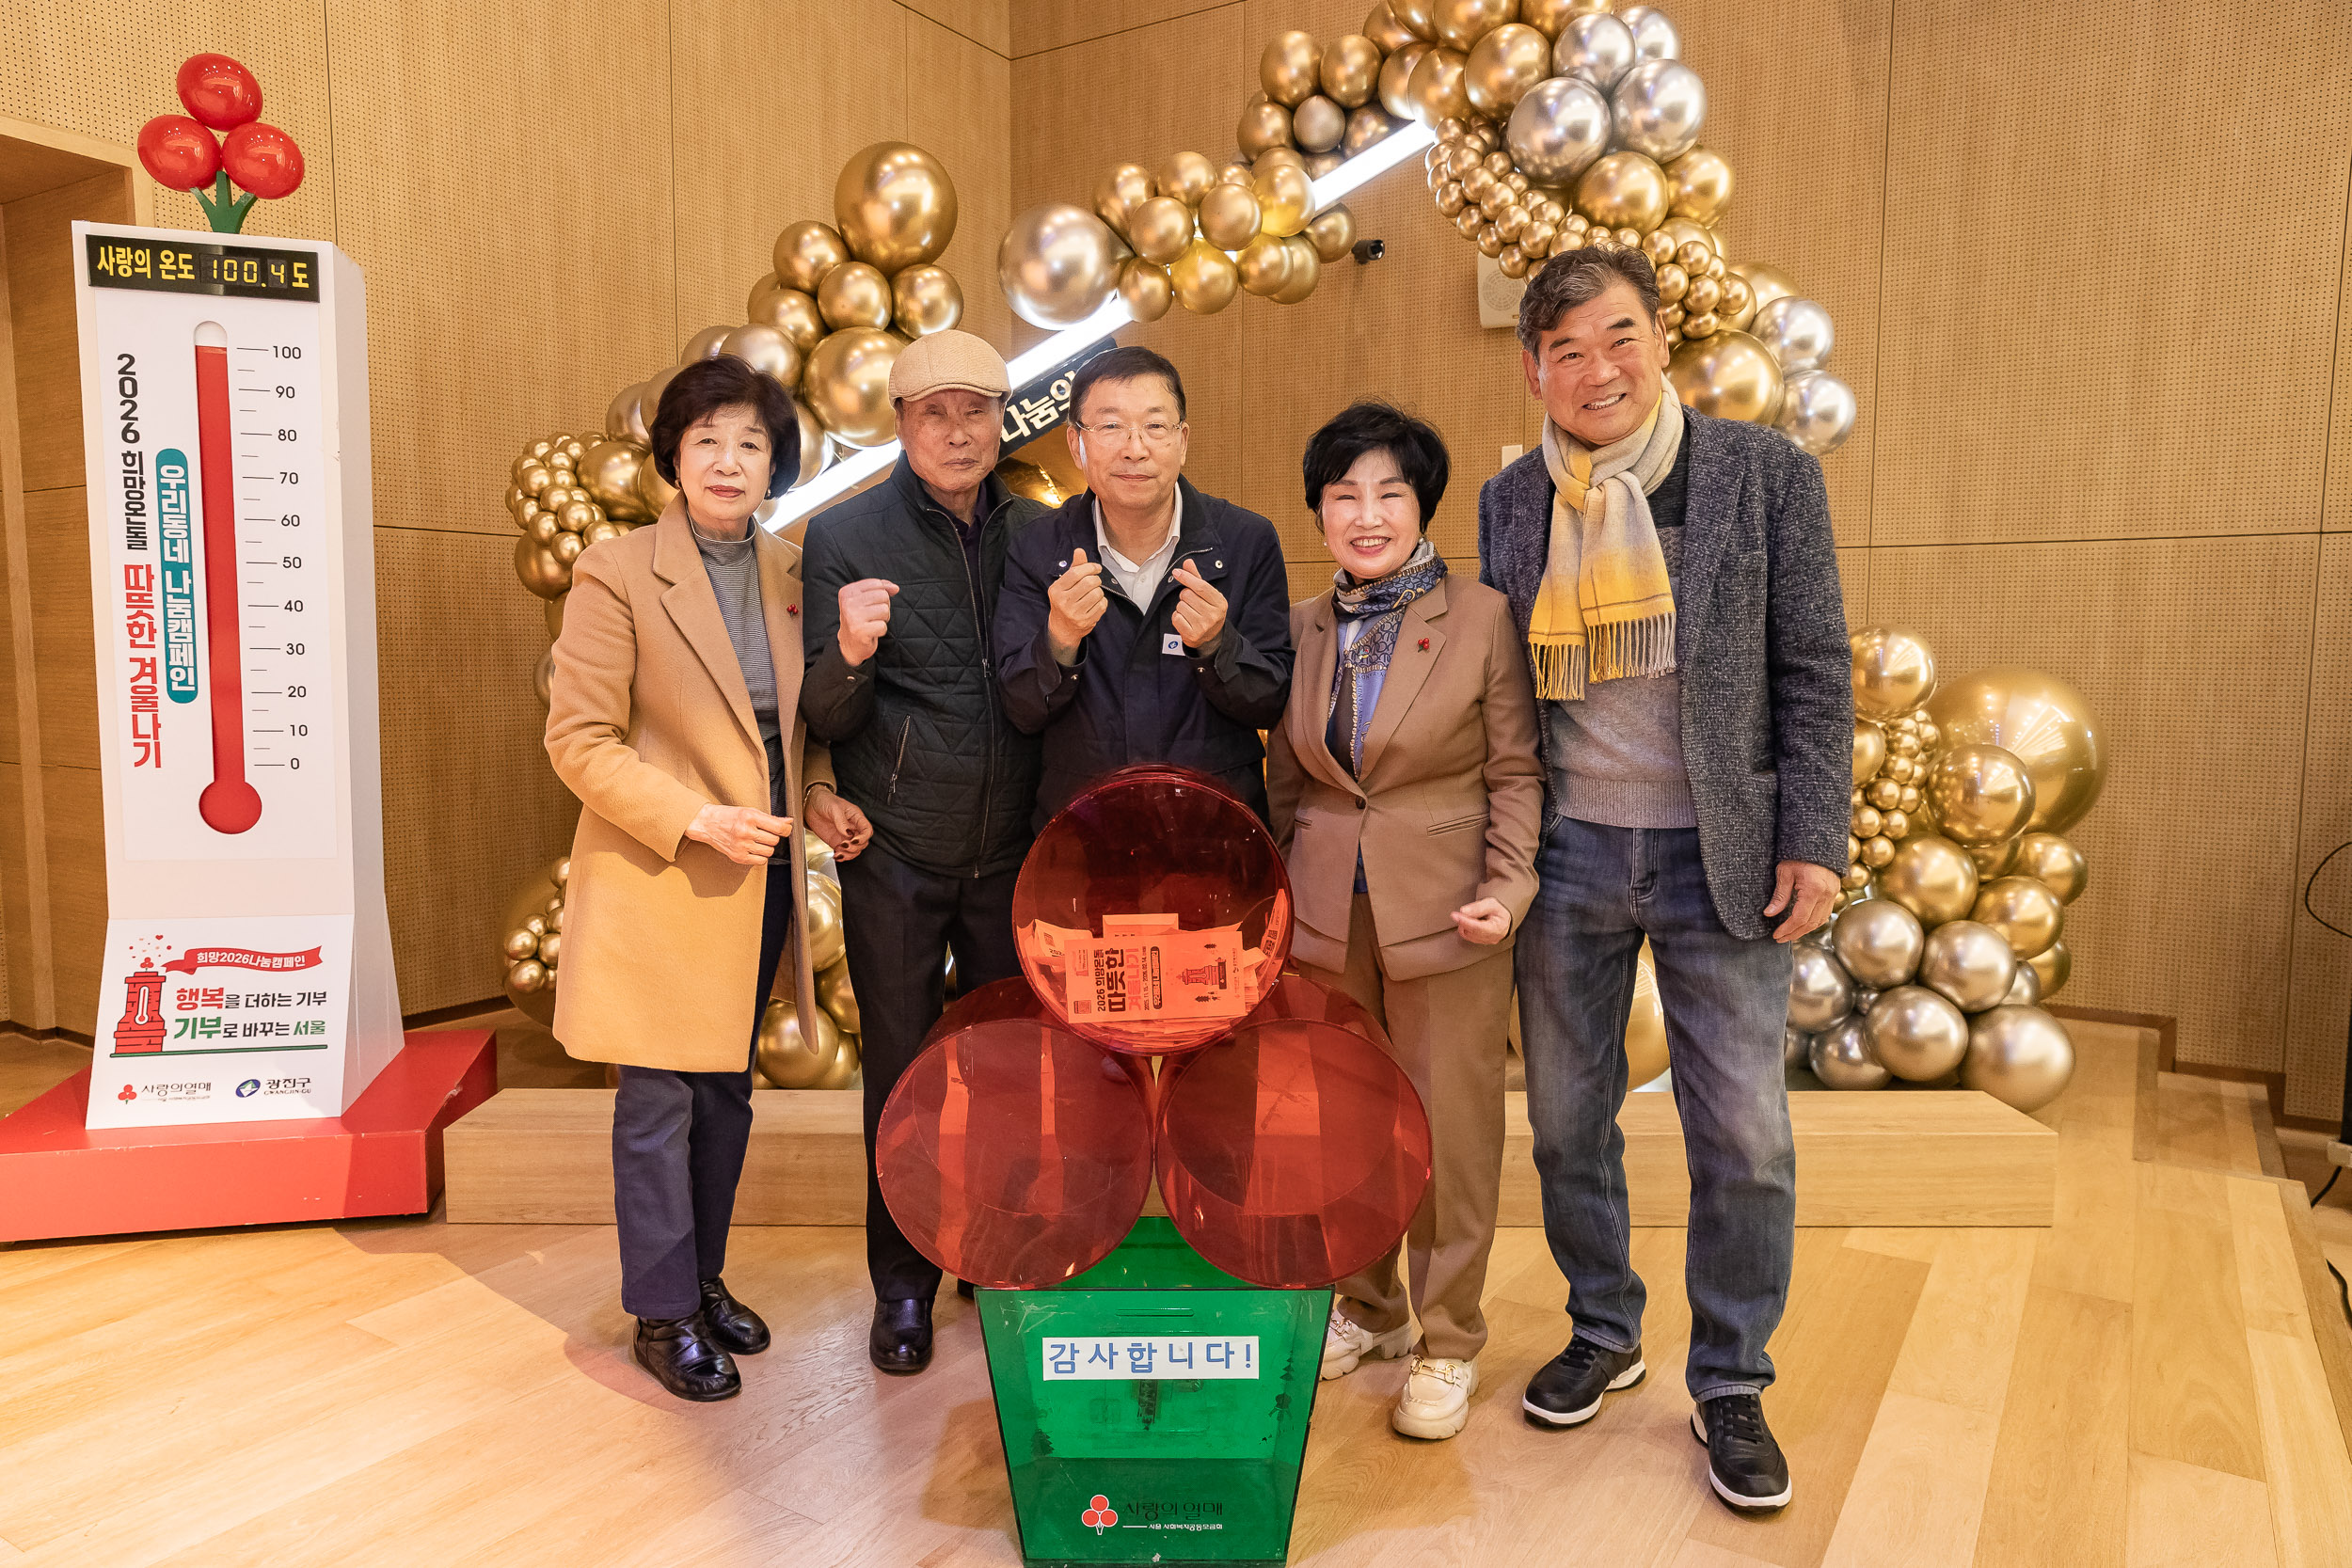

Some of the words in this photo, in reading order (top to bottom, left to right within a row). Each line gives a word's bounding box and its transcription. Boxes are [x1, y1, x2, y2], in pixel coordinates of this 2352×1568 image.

[97, 245, 151, 279] 사랑의
[158, 249, 196, 280] 온도
[213, 259, 285, 288] 100.4
[292, 261, 310, 289] 도
[272, 345, 302, 360] 100
[117, 353, 140, 444] 2026
[275, 386, 296, 400] 90
[277, 429, 297, 442] 80
[279, 472, 299, 484] 70
[120, 451, 148, 551] 희망온돌
[159, 465, 190, 563] 우리동네
[280, 515, 301, 528] 60
[282, 557, 302, 569] 50
[123, 563, 158, 649] 따뜻한
[284, 600, 304, 612] 40
[165, 570, 196, 691] 나눔캠페인
[285, 643, 306, 656] 30
[287, 686, 307, 699] 20
[129, 657, 162, 768] 겨울나기
[290, 724, 308, 737] 10
[290, 757, 300, 770] 0
[196, 951, 306, 968] 희망2026나눔캠페인
[1104, 947, 1126, 1013] 따뜻한
[176, 987, 240, 1012] 행복을
[245, 992, 292, 1008] 더하는
[296, 990, 327, 1006] 기부
[1096, 989, 1106, 1012] 2026
[173, 1016, 238, 1039] 기부로
[243, 1021, 291, 1037] 바꾸는
[294, 1020, 326, 1036] 서울
[265, 1078, 311, 1089] 광진구
[1048, 1341, 1251, 1374] 감사합니다!
